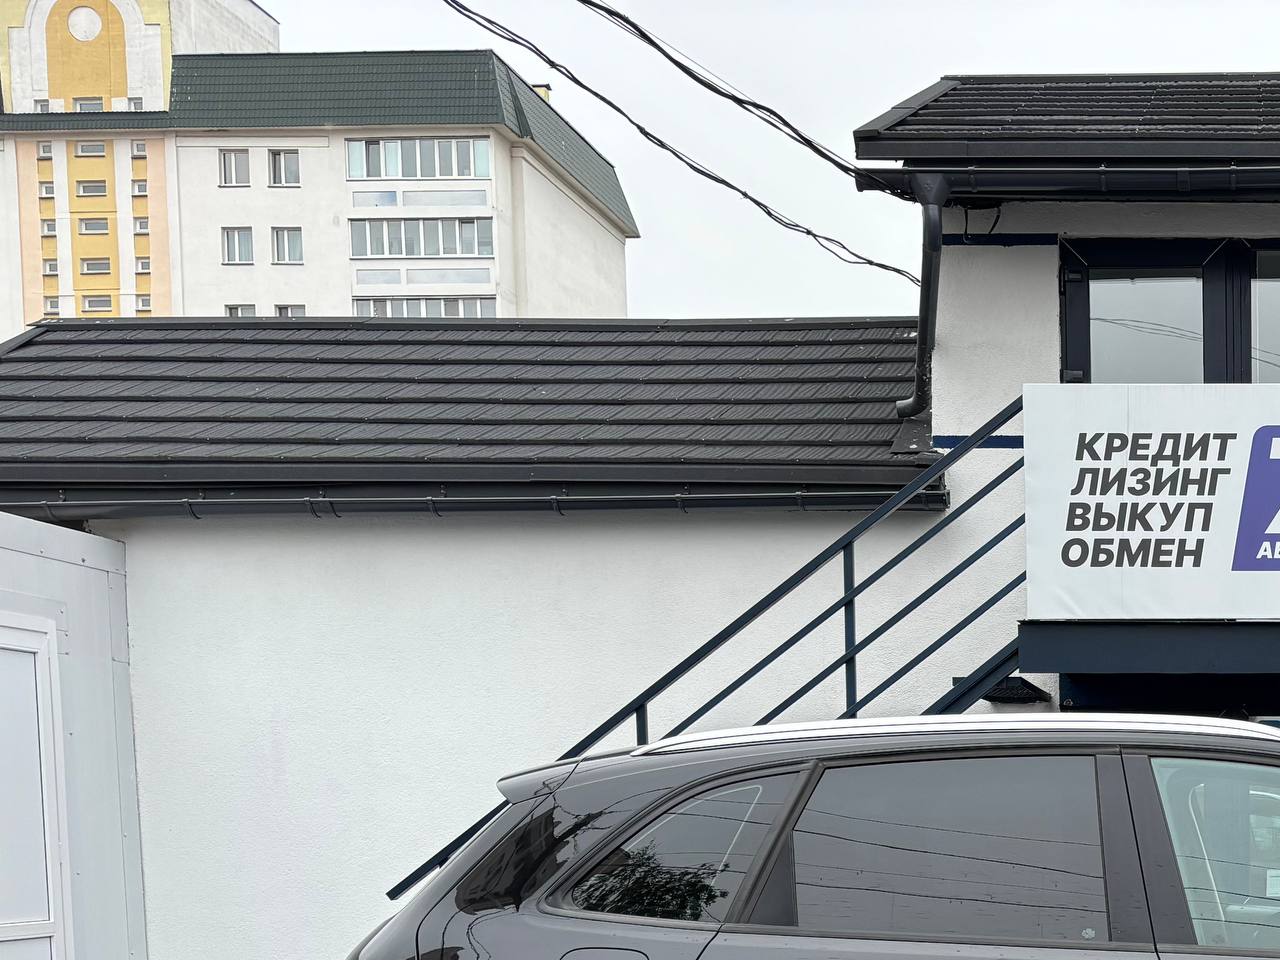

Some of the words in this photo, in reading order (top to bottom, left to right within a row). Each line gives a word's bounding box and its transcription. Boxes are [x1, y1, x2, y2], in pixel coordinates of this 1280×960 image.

[1075, 432, 1238, 467] КРЕДИТ
[1070, 467, 1232, 497] ЛИЗИНГ
[1065, 502, 1214, 532] ВЫКУП
[1061, 537, 1205, 568] ОБМЕН
